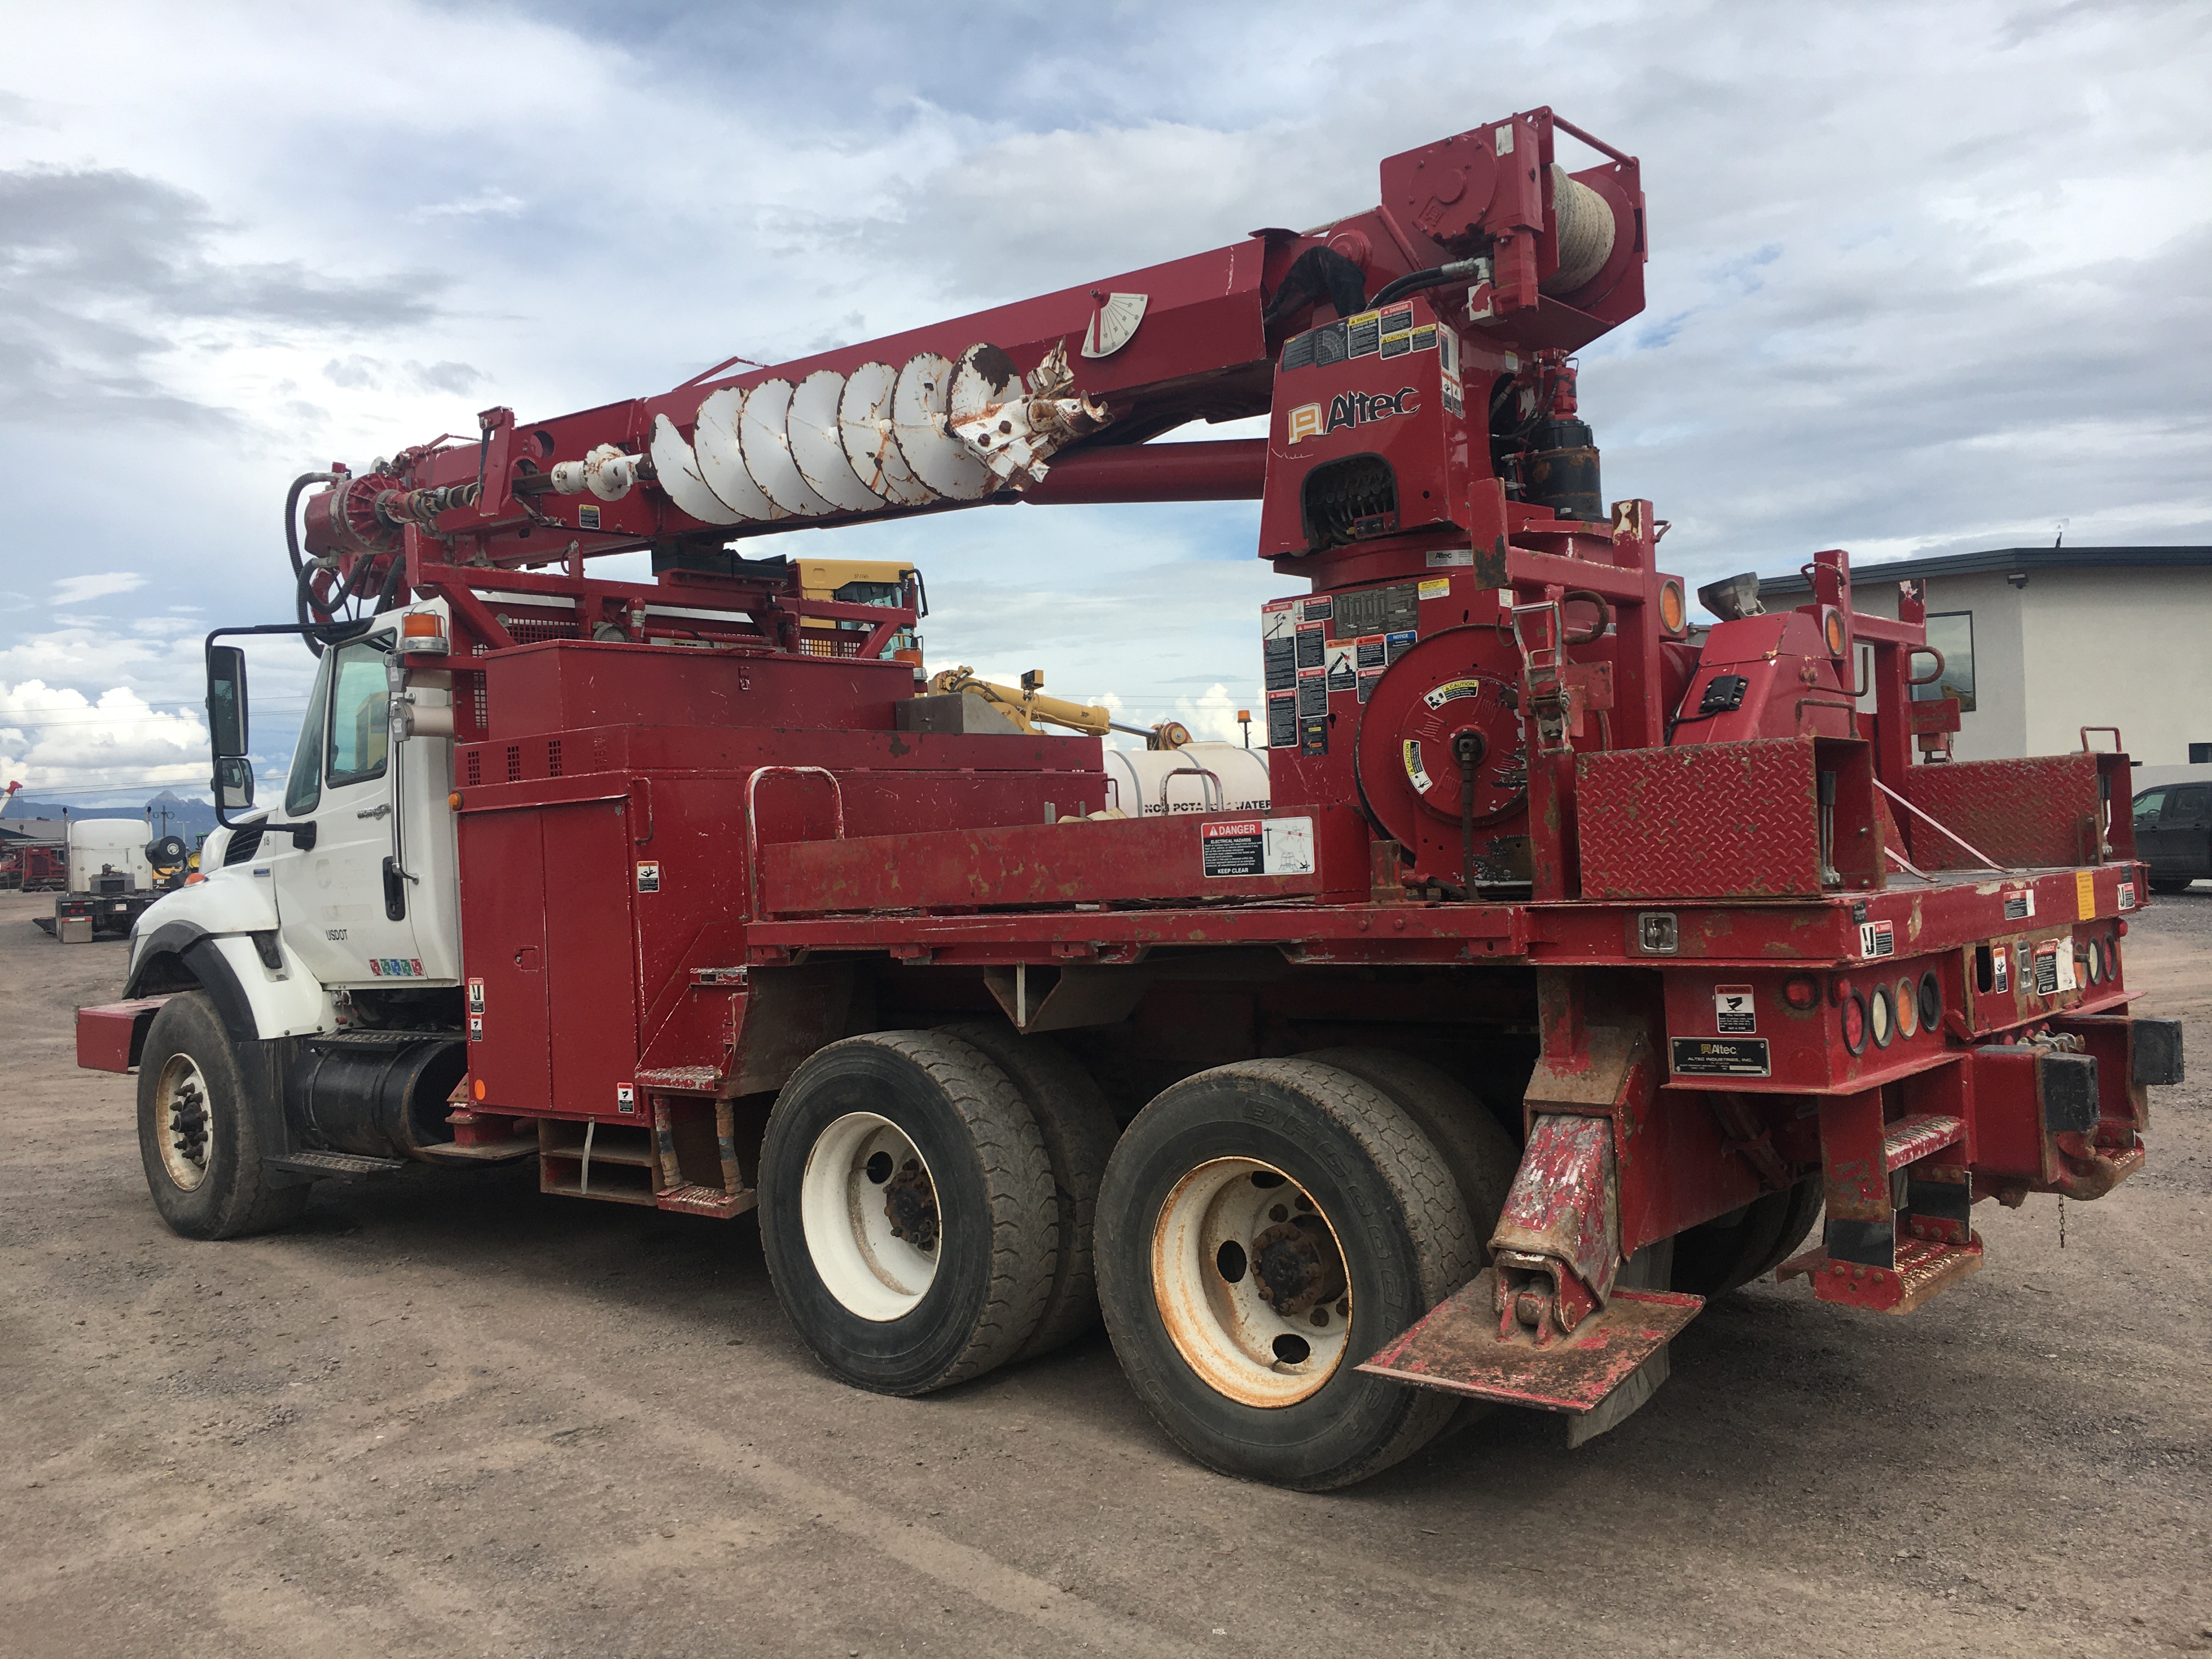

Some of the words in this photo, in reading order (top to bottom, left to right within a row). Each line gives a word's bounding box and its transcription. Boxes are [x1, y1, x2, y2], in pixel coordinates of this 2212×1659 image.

[1389, 304, 1409, 313] DANGER
[1387, 332, 1409, 342] CAUTION
[1323, 387, 1421, 435] Altec
[1234, 800, 1271, 810] WATER
[1218, 824, 1256, 835] DANGER
[325, 929, 348, 941] USDOT
[1711, 1045, 1737, 1054] Altec
